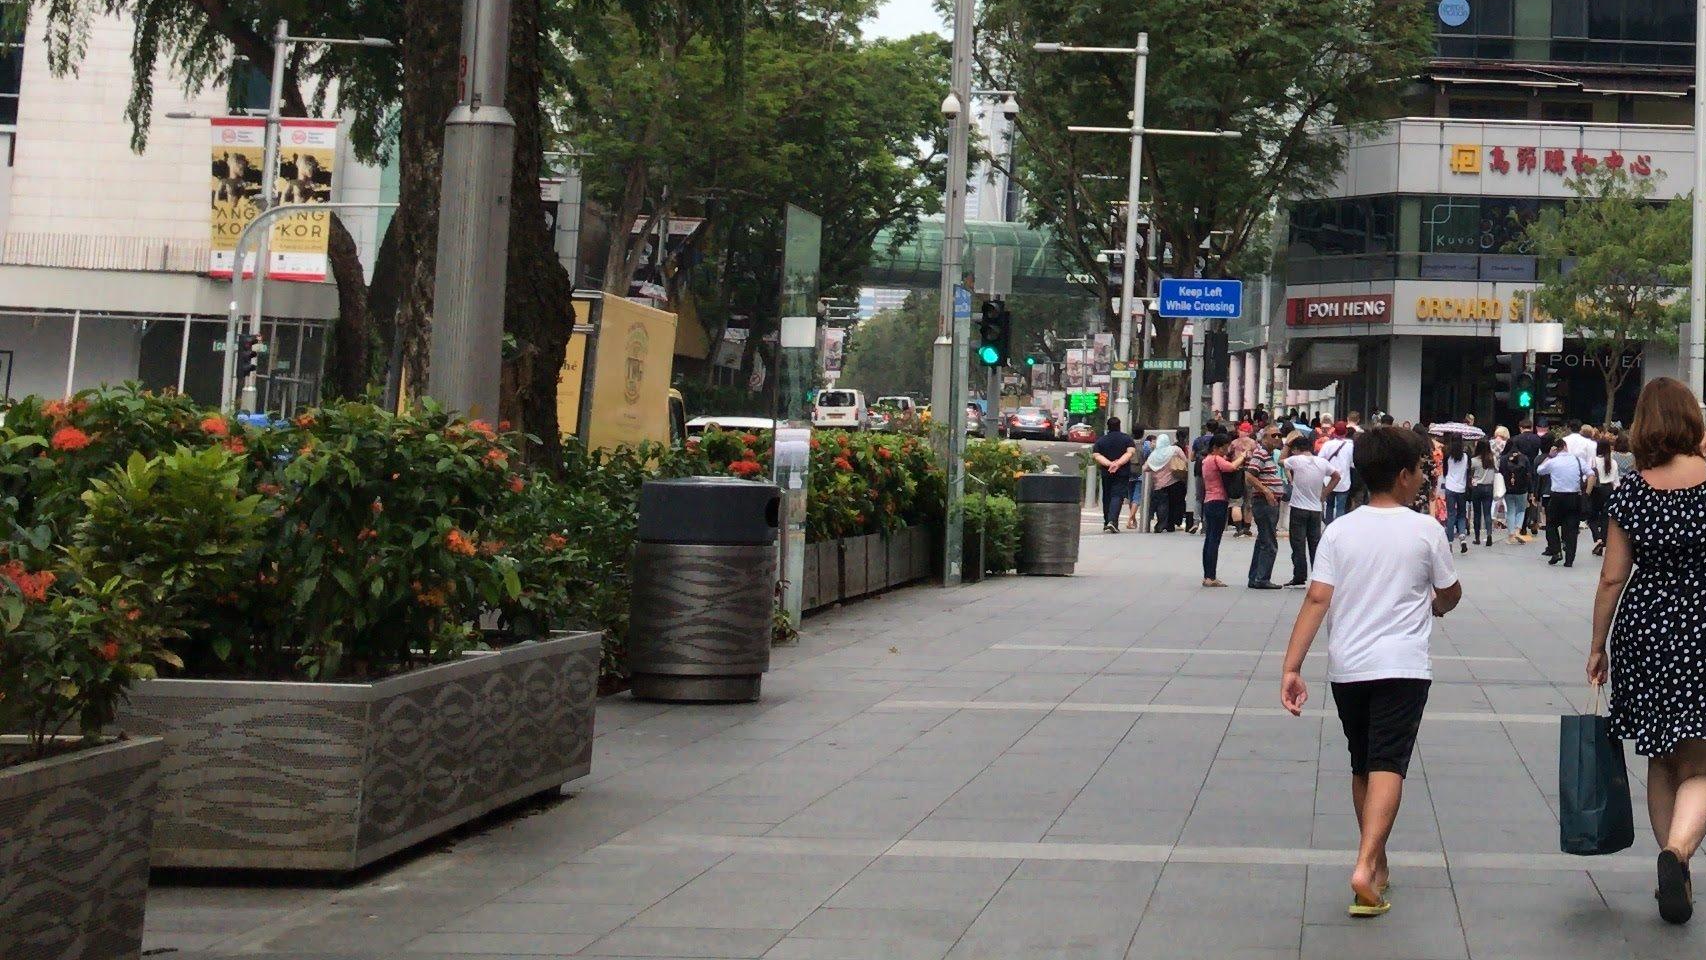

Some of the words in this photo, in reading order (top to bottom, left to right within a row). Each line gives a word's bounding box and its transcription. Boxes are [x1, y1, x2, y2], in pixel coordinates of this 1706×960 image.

[216, 207, 256, 220] ANG
[281, 224, 322, 238] KOR
[1178, 286, 1203, 299] Keep
[1204, 286, 1223, 297] Left
[1165, 300, 1192, 311] While
[1193, 300, 1235, 314] Crossing
[1308, 301, 1340, 318] POH
[1342, 300, 1387, 317] HENG
[1416, 296, 1503, 322] ORCHARD
